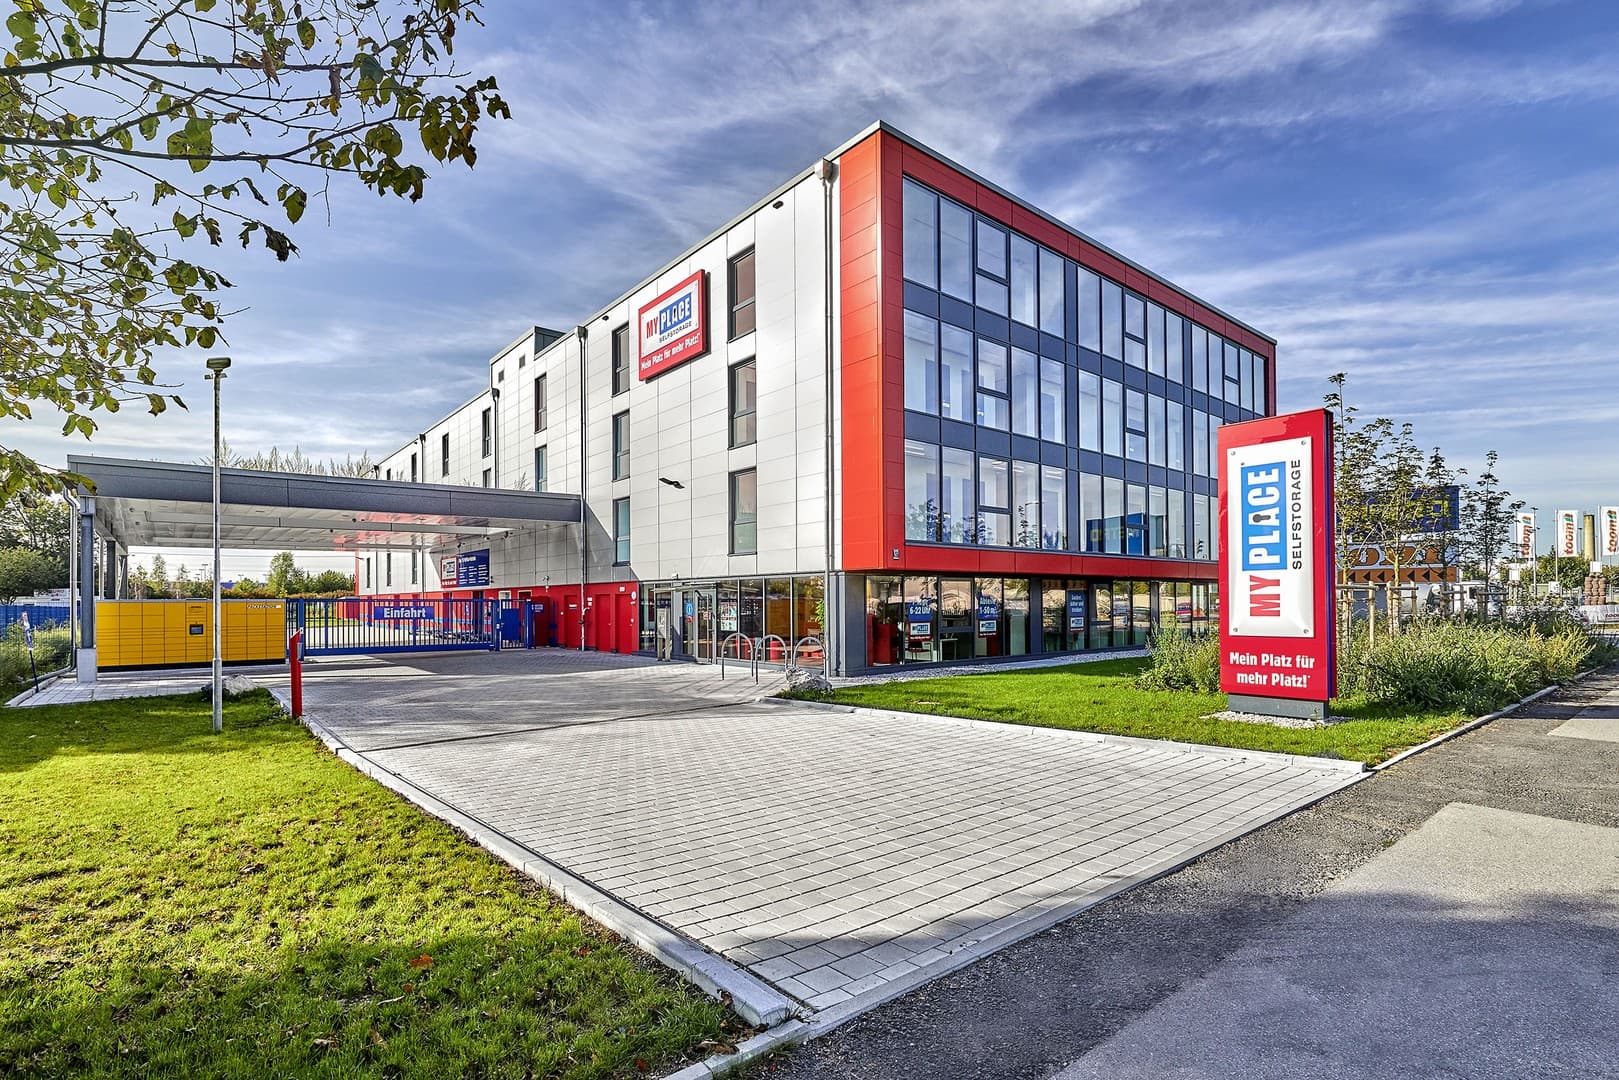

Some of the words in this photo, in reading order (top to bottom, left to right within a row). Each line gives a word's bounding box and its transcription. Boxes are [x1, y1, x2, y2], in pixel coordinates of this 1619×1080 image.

[646, 316, 658, 339] MY
[661, 297, 690, 331] PLACE
[1247, 468, 1280, 565] PLACE
[1291, 459, 1302, 570] SELFSTORAGE
[1564, 522, 1574, 555] toom
[1607, 519, 1617, 553] toom
[383, 607, 426, 618] Einfahrt
[1250, 575, 1280, 617] MY
[1229, 651, 1258, 666] Mein
[1261, 653, 1292, 668] Platz
[1295, 654, 1315, 669] für
[1236, 671, 1268, 685] mehr
